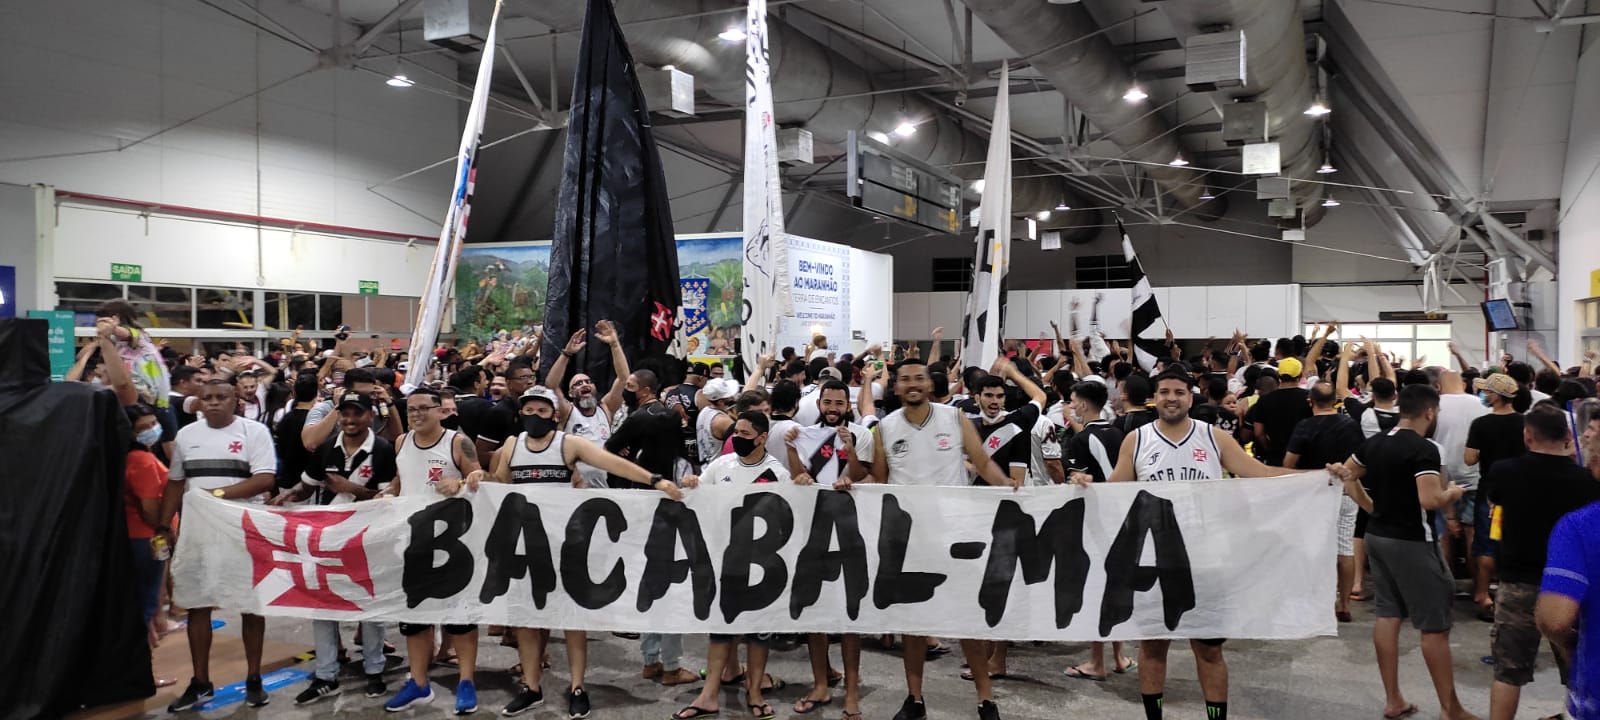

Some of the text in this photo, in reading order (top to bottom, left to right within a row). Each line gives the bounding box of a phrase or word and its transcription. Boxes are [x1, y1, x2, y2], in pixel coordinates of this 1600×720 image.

[112, 264, 141, 275] SAÍDA
[799, 260, 833, 275] BEM-VINDO
[794, 276, 838, 292] AO MARANHÃO
[402, 490, 1196, 638] BACABAL-MA
